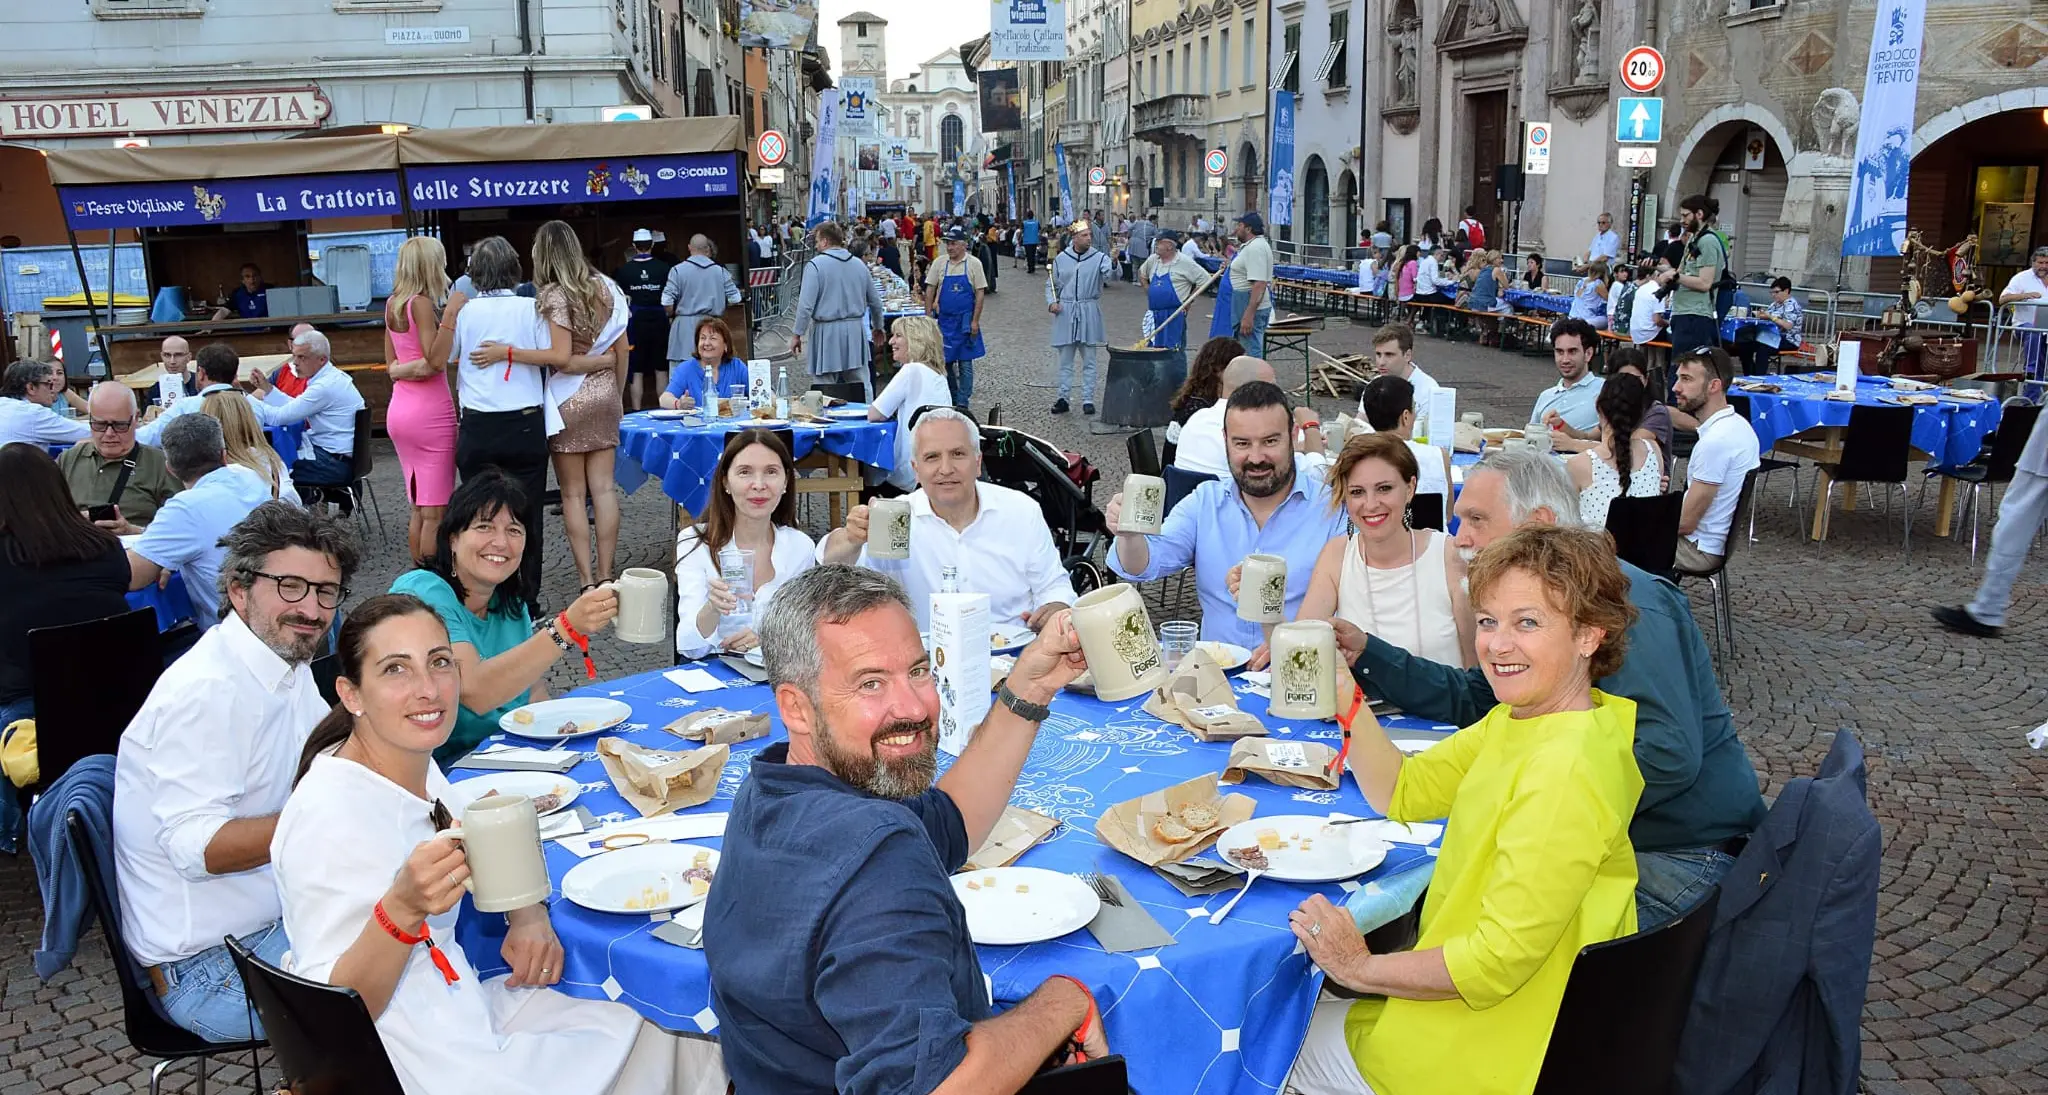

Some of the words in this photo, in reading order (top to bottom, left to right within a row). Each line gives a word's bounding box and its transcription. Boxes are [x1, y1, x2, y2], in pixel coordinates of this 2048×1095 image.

[392, 31, 421, 40] PIAZZA
[434, 30, 462, 40] DUOMO
[12, 102, 129, 130] HOTEL
[151, 96, 309, 126] VENEZIA
[689, 167, 728, 177] CONAD
[256, 192, 287, 212] La
[300, 188, 396, 210] Trattoria
[413, 179, 458, 201] delle
[468, 176, 570, 198] Strozzere
[87, 201, 125, 216] Feste
[127, 199, 185, 219] Vigiliane
[1287, 693, 1314, 701] FORST
